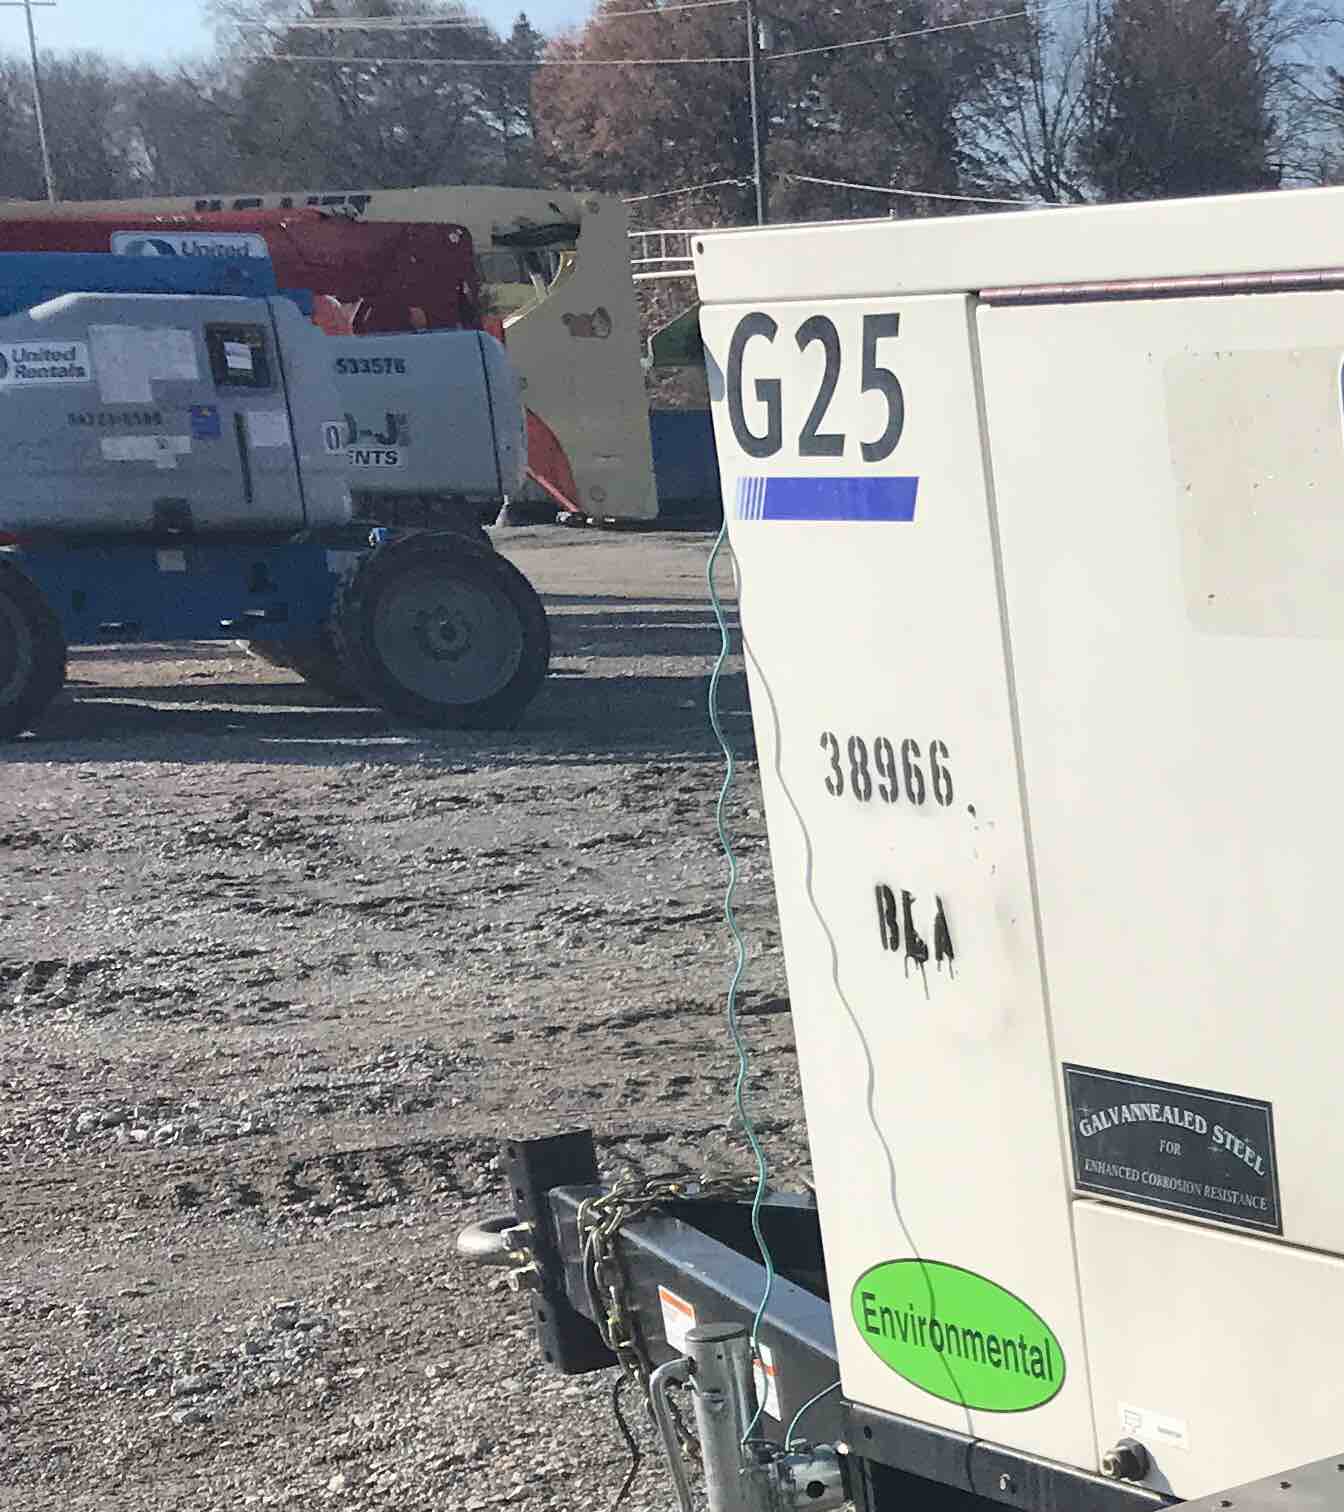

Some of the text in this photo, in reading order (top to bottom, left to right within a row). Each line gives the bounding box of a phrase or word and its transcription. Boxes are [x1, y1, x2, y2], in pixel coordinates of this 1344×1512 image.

[12, 346, 76, 363] United
[15, 363, 85, 378] Rentals
[727, 311, 905, 462] G25
[820, 731, 954, 807] 38966
[1079, 1103, 1266, 1177] GALVANNEALED STEEL
[1159, 1139, 1182, 1156] FOR
[1085, 1159, 1268, 1211] ENHANCED CORROSION RESISTANCE
[862, 1291, 1054, 1382] Environmental
